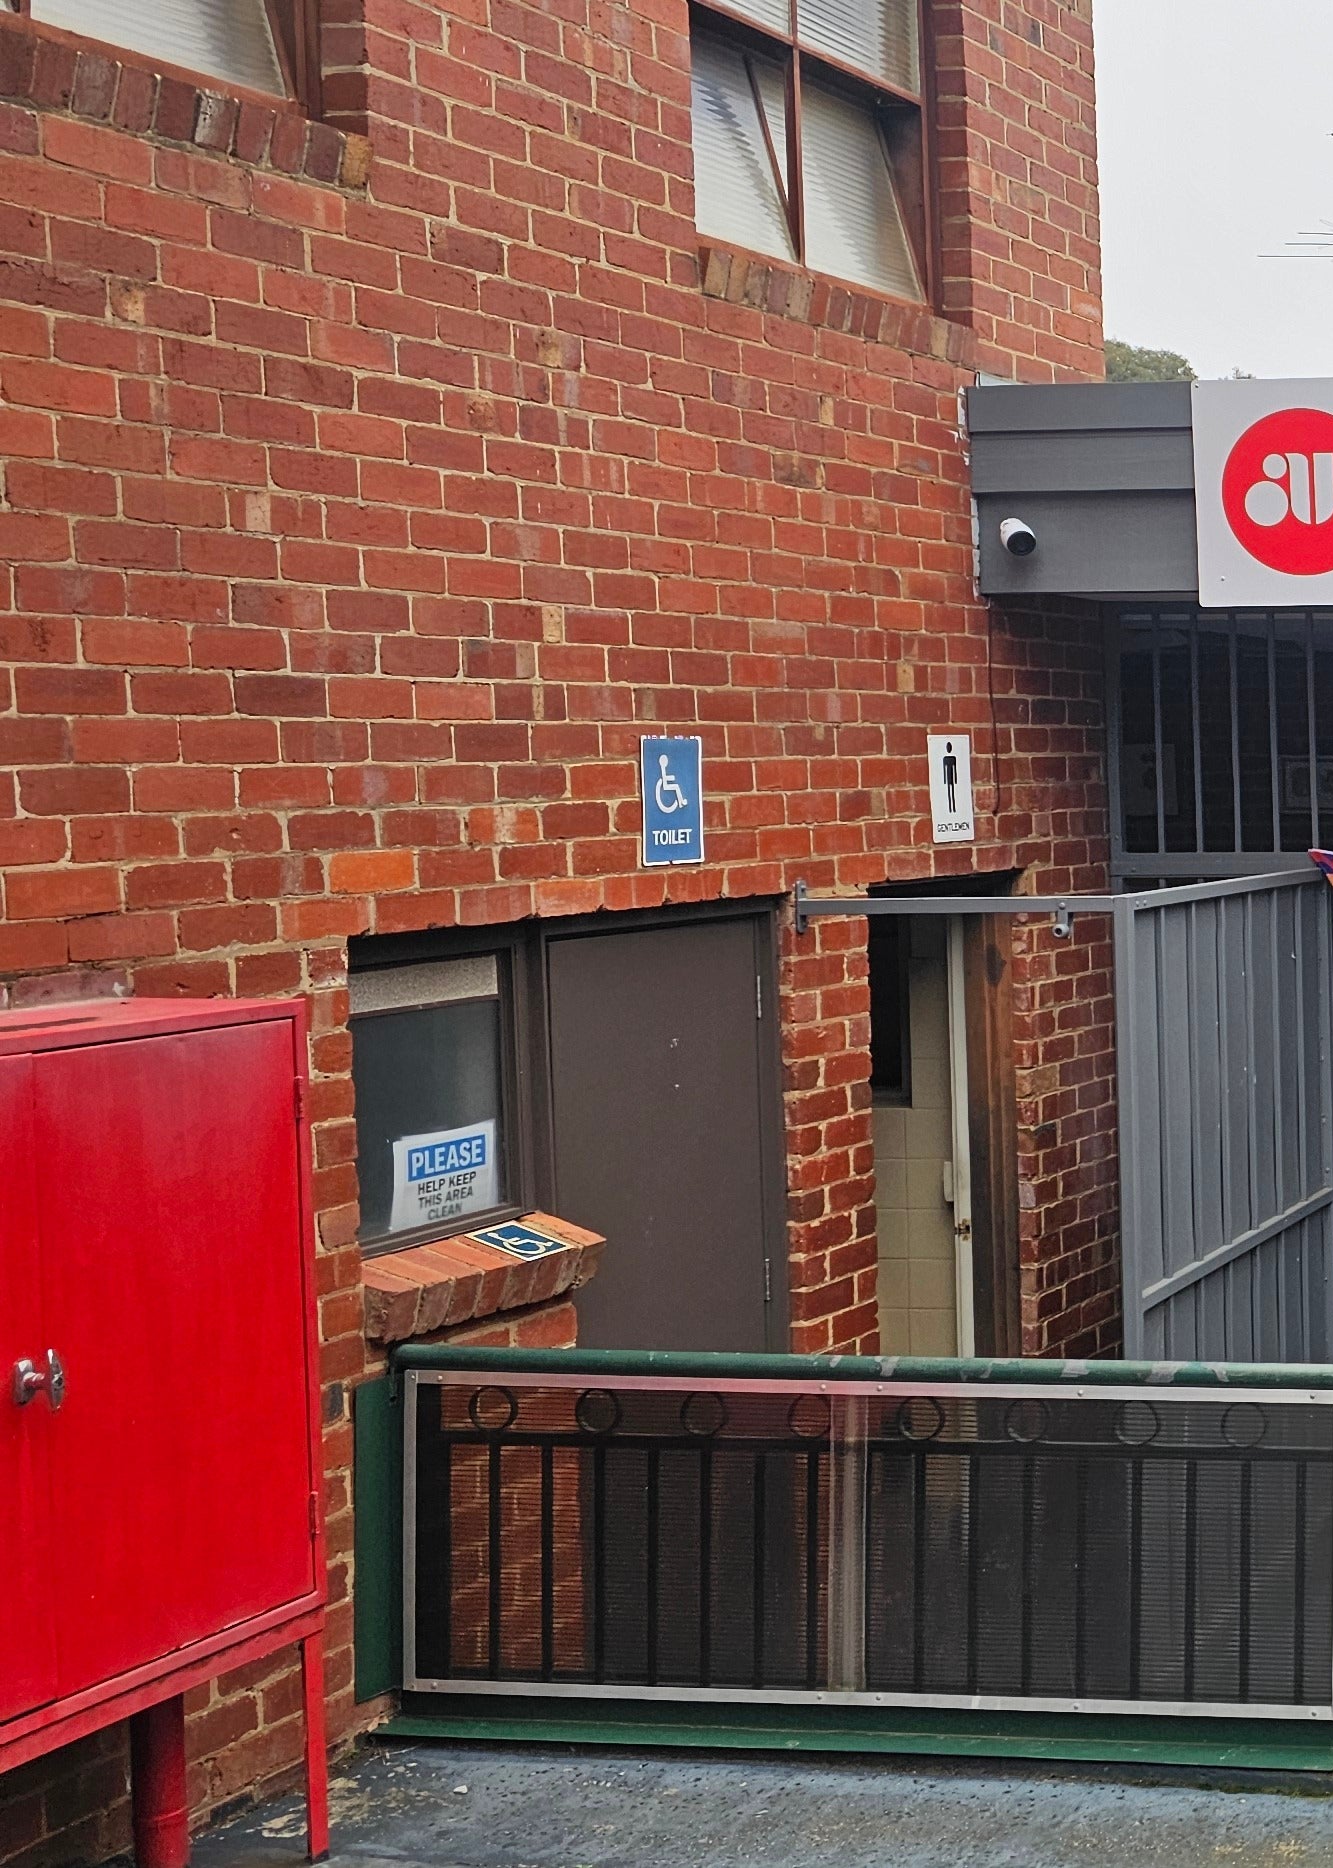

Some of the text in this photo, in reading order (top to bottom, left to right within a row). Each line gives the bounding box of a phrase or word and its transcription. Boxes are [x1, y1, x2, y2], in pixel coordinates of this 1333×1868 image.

[652, 828, 693, 846] TOILET
[411, 1138, 483, 1177] PLEASE
[417, 1171, 477, 1196] HELP KEEP
[417, 1185, 474, 1209] THIS AREA
[427, 1202, 463, 1221] CLEAN
